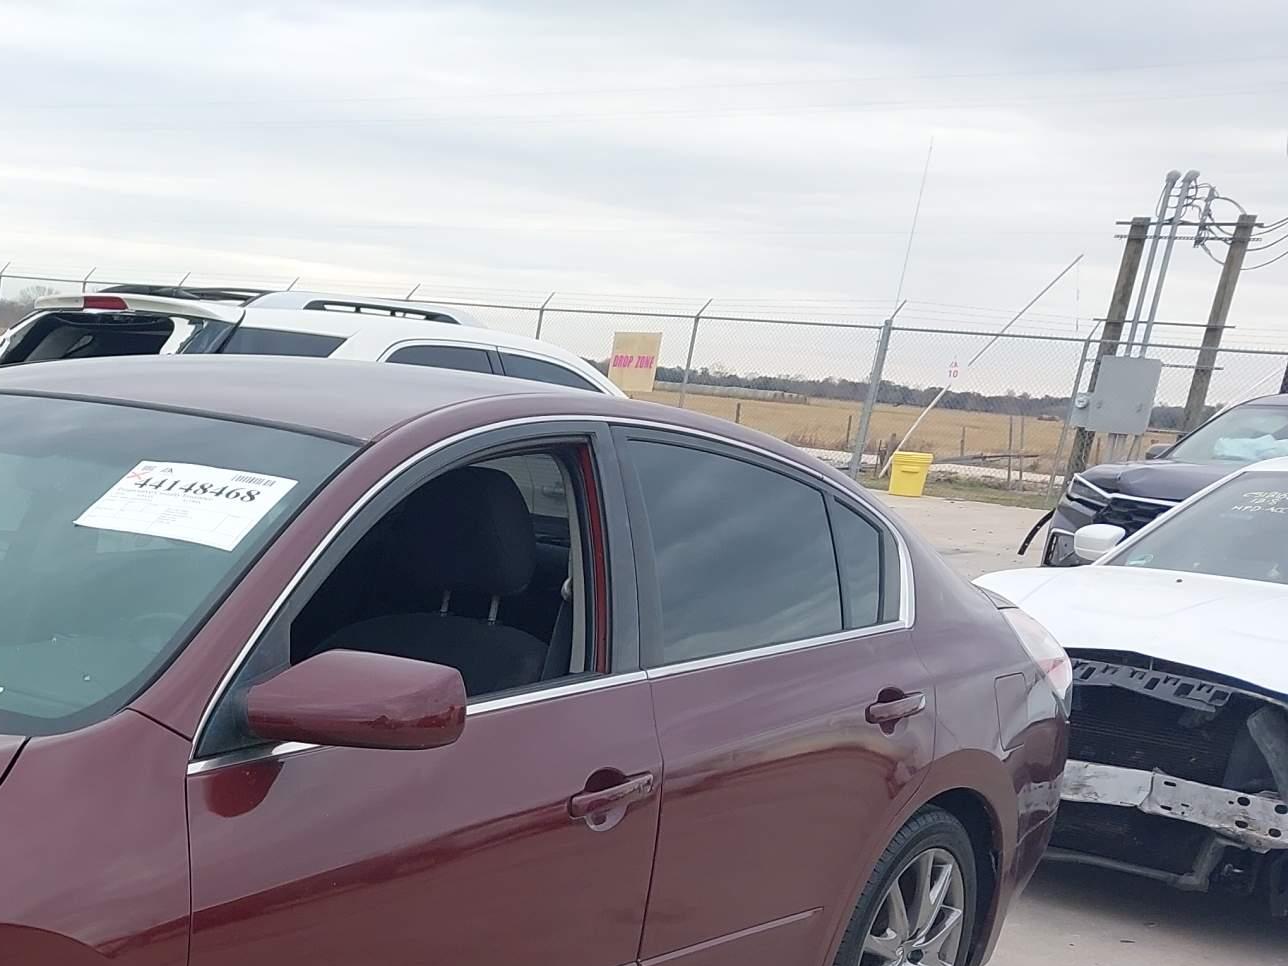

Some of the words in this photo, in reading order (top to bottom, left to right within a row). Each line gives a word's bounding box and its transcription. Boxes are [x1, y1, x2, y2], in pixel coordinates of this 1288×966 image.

[612, 354, 633, 369] DROP
[635, 355, 656, 369] ZONE
[133, 476, 261, 503] 44148468
